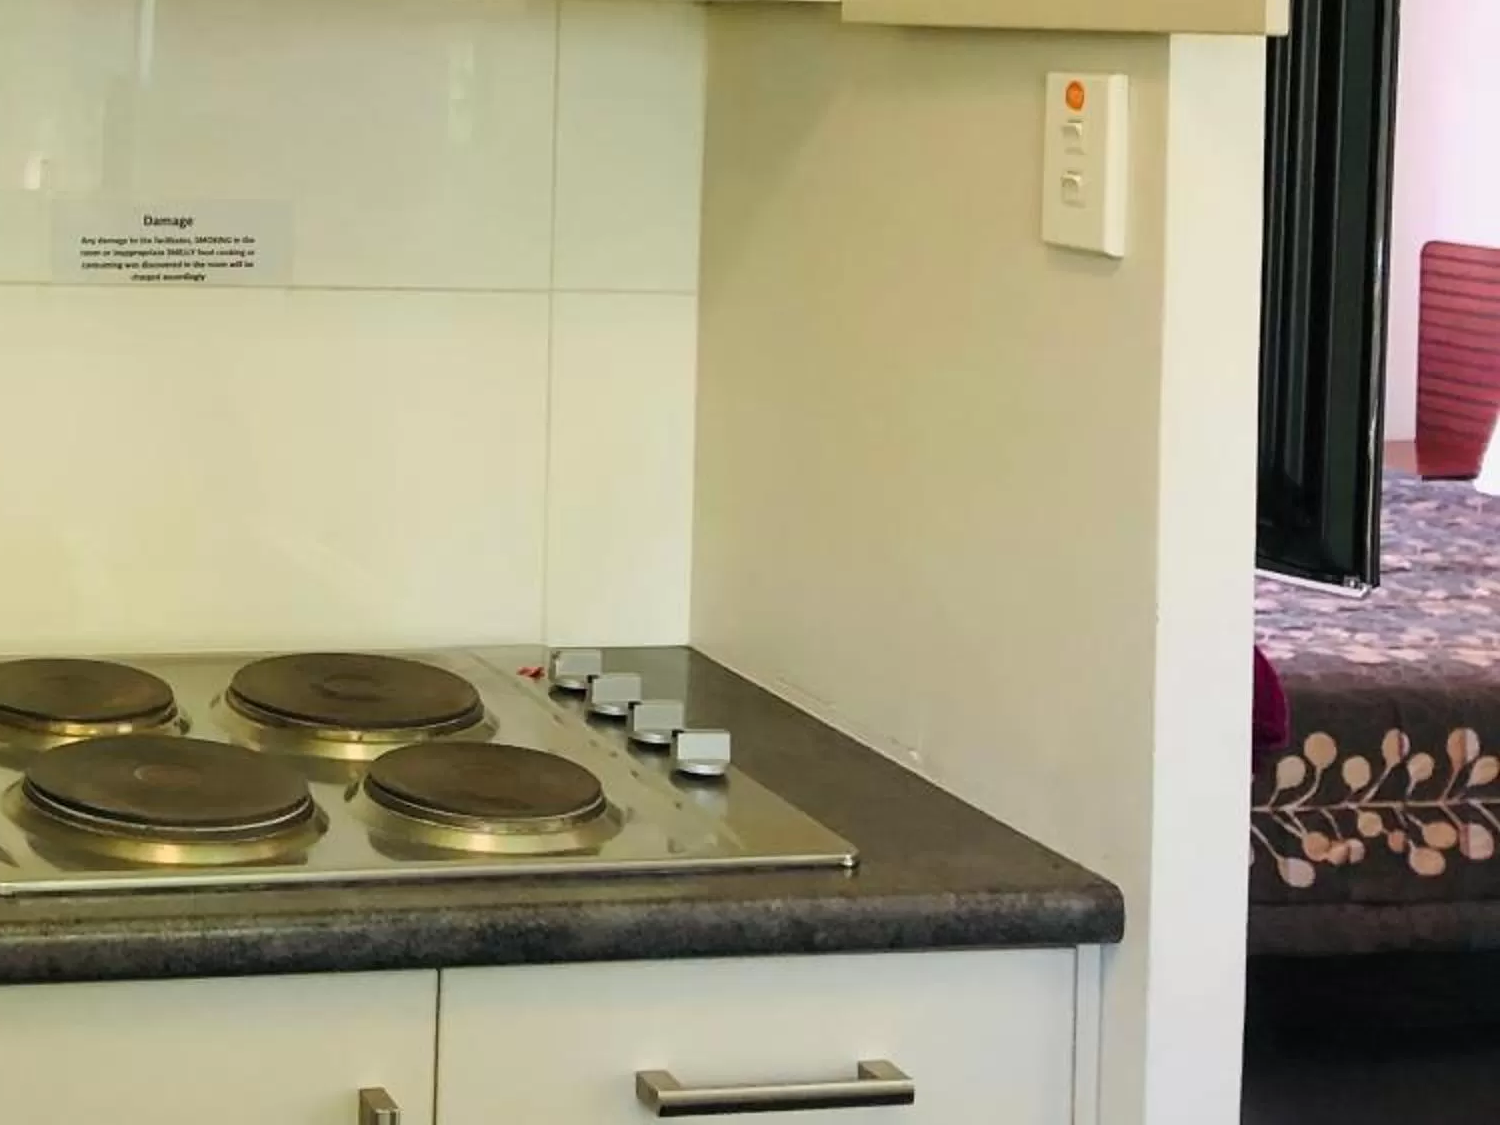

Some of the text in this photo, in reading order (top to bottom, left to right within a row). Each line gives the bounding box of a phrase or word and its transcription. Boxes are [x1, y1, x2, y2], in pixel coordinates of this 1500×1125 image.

[144, 215, 193, 228] Damage
[81, 236, 95, 245] Any
[98, 236, 128, 245] damage
[194, 236, 232, 244] SMOKING
[242, 236, 255, 244] the
[113, 248, 164, 257] inappropriate
[167, 248, 195, 256] SMELLY
[198, 248, 214, 256] food
[216, 248, 245, 257] cooking
